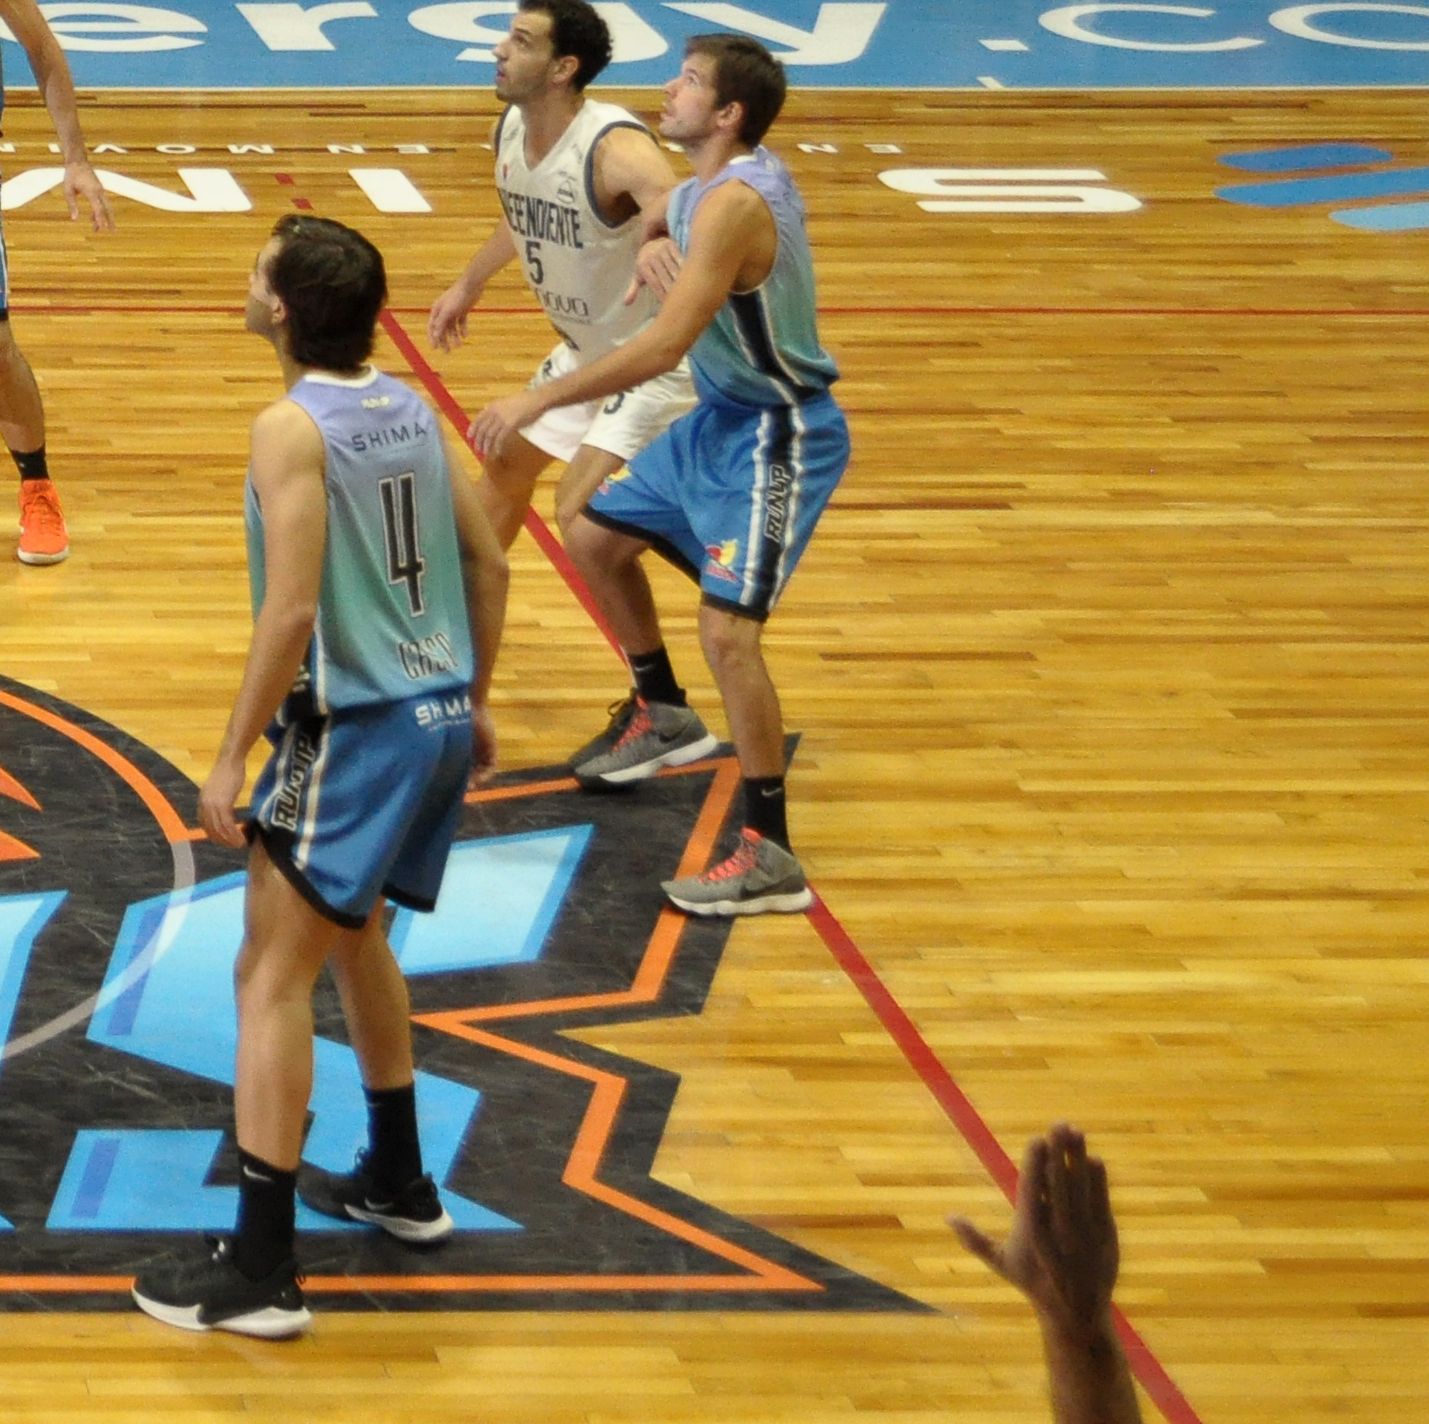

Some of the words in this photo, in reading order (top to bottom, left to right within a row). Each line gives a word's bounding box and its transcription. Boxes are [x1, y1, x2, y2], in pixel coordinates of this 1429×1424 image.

[327, 143, 430, 155] EN
[524, 240, 545, 286] 5
[350, 422, 428, 453] SHIMA
[377, 471, 428, 619] 4
[415, 695, 472, 727] SHMA
